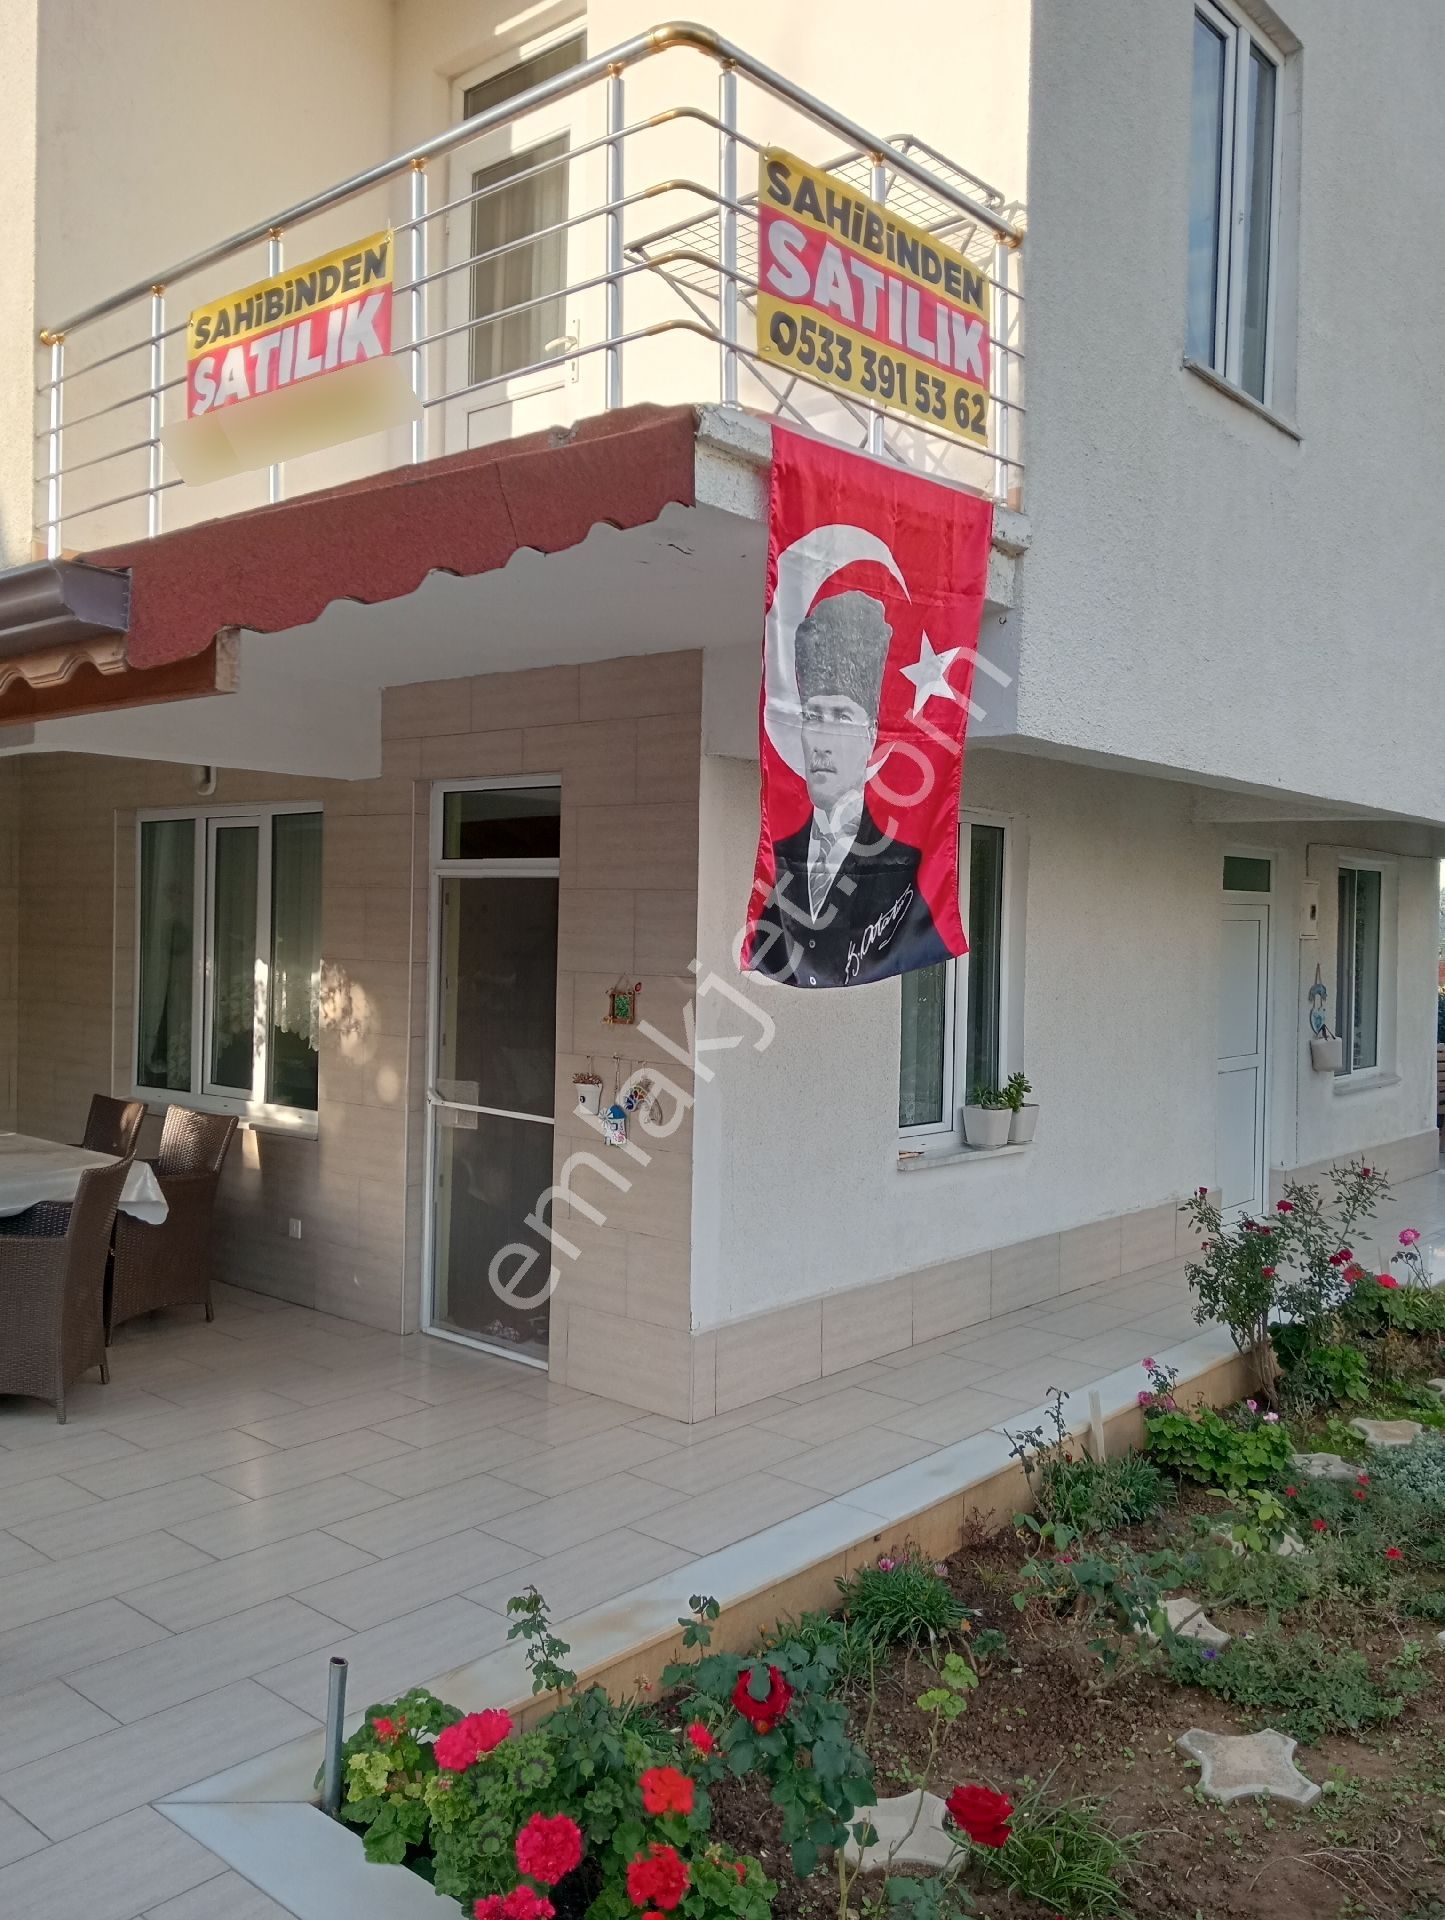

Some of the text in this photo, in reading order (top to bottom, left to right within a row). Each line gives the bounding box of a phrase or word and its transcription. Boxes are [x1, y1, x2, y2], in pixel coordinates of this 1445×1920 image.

[193, 293, 385, 415] SATILIK
[766, 220, 984, 379] SATILIK
[769, 311, 986, 436] 0533 391 53 62
